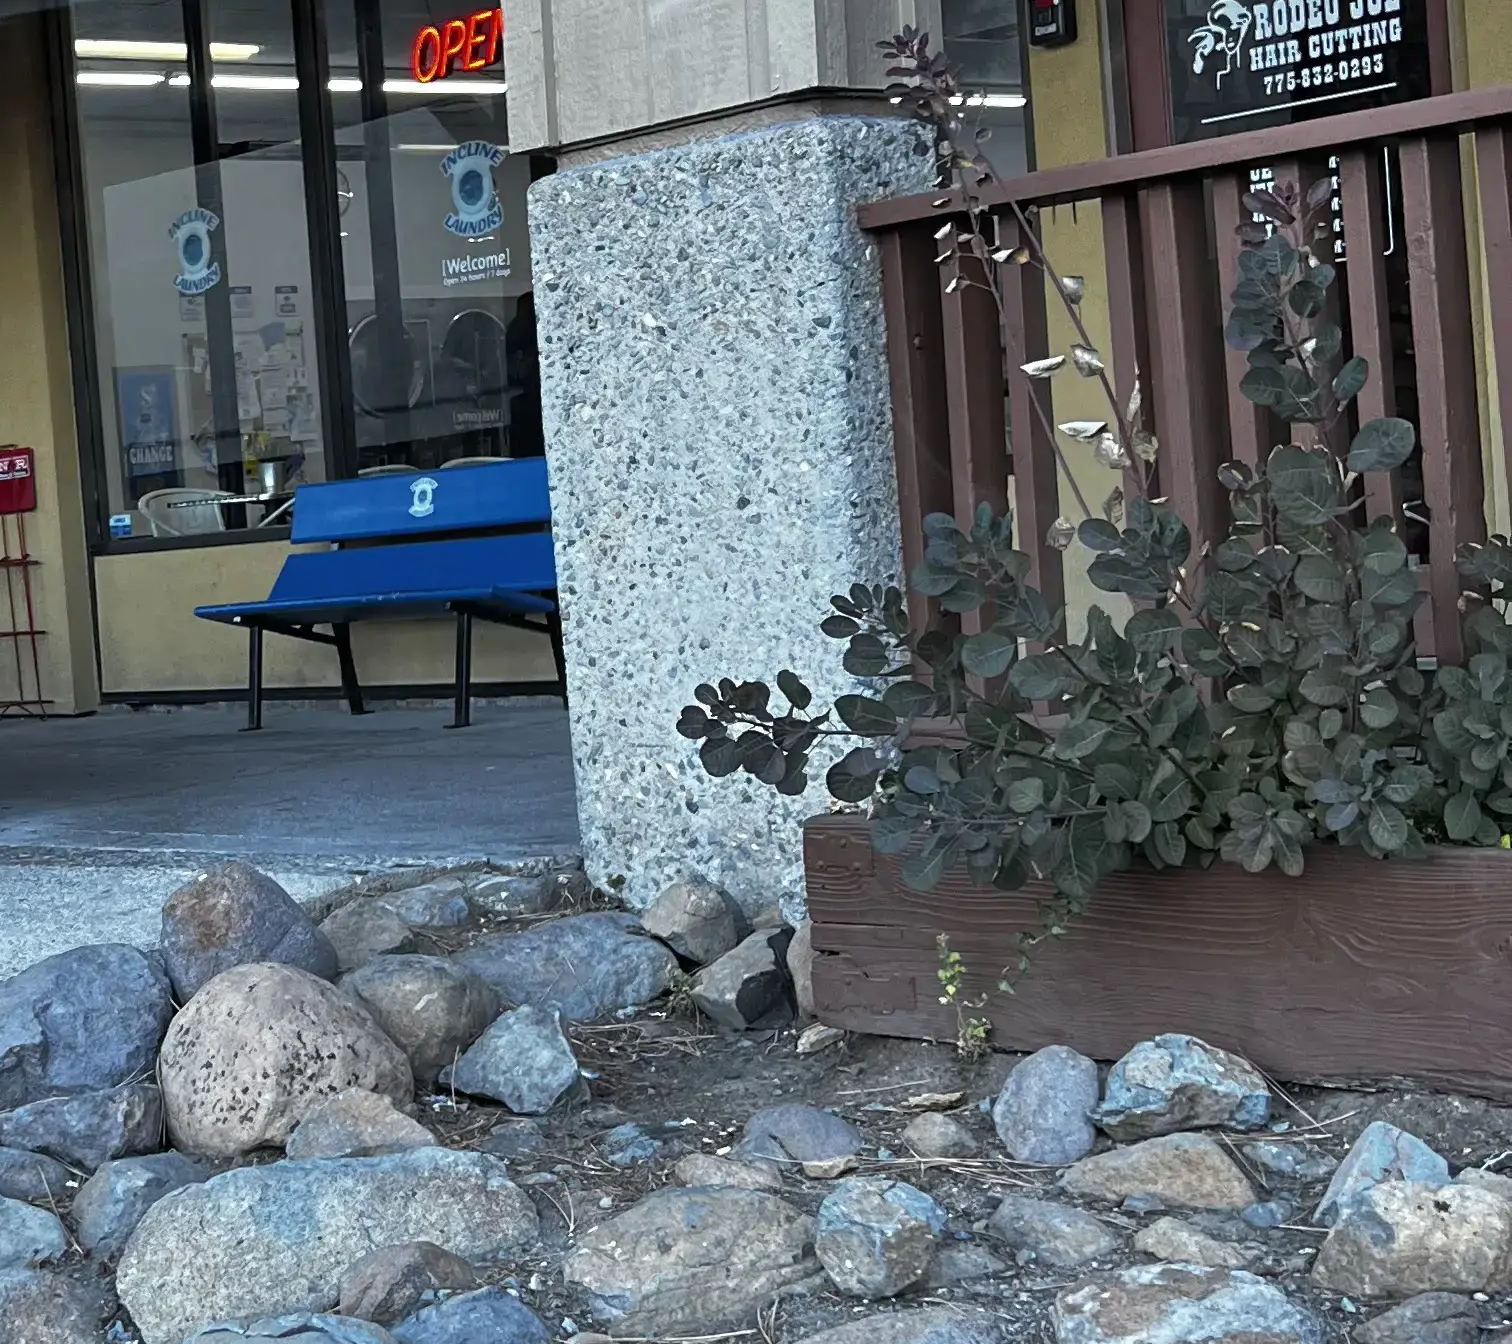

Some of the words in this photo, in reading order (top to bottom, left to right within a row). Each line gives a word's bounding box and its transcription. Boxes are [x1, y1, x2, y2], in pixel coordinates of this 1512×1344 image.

[1249, 39, 1302, 71] HAIR
[1308, 17, 1402, 58] CUTTING
[1264, 53, 1384, 95] 775-832-0293
[441, 141, 505, 176] INCLINE
[444, 205, 503, 235] LAUNDRY
[129, 445, 173, 465] CHANGE
